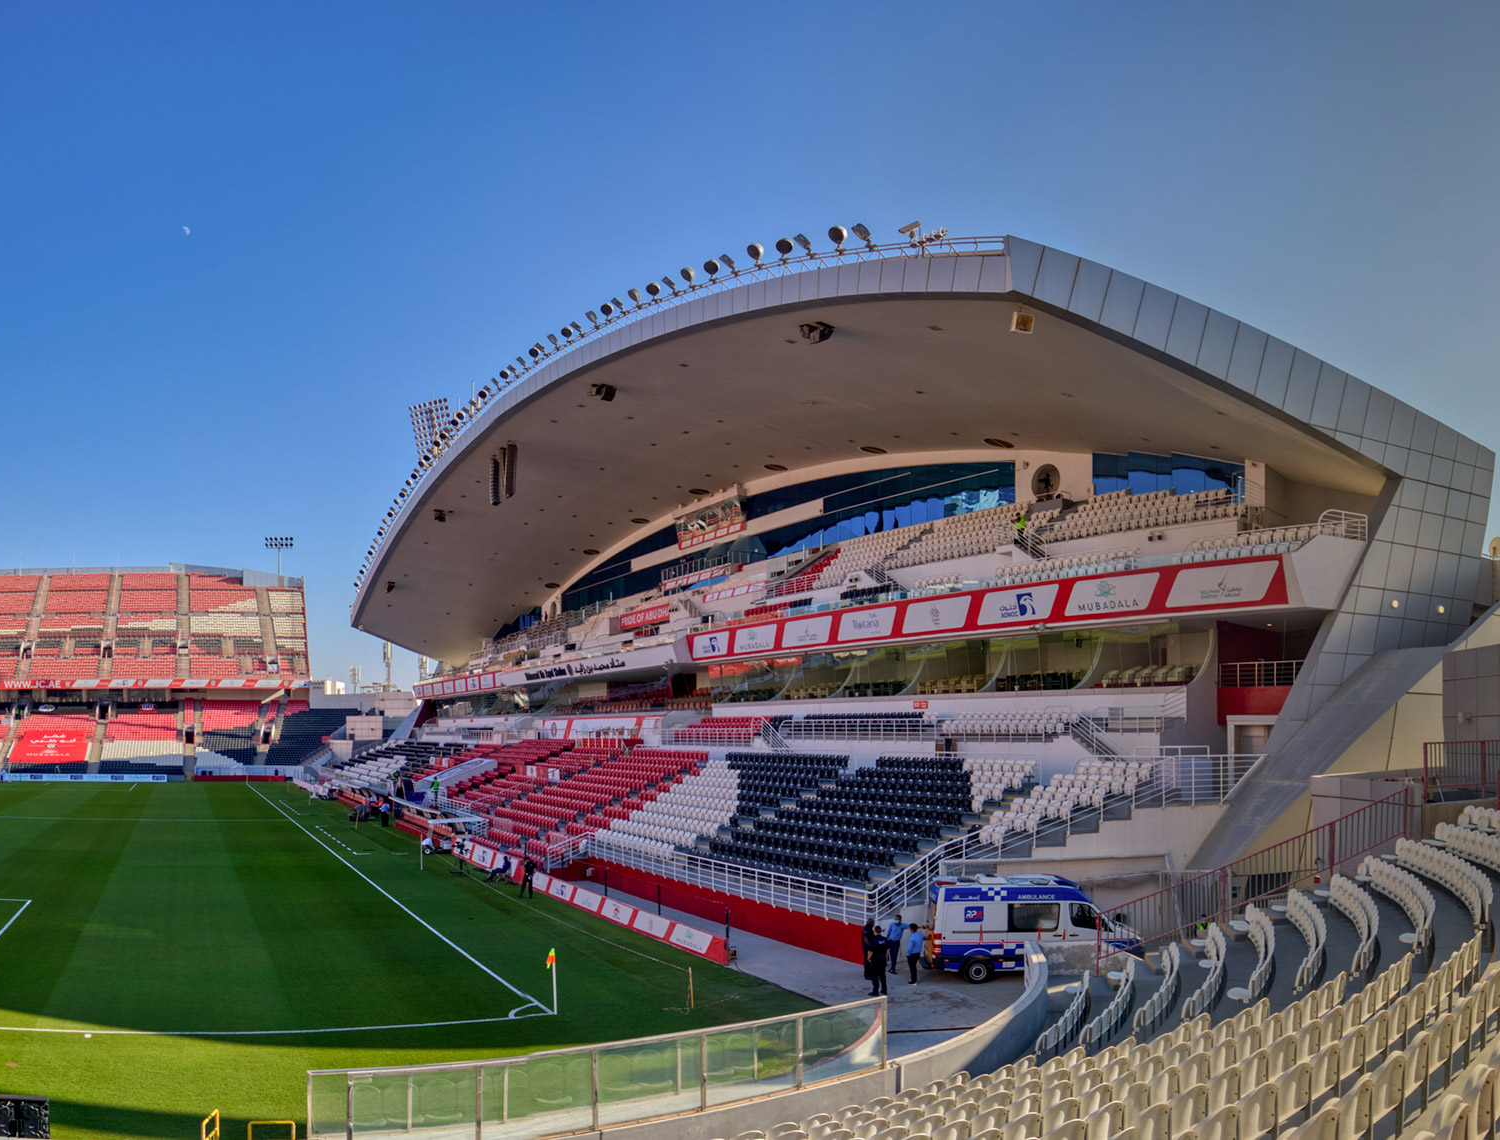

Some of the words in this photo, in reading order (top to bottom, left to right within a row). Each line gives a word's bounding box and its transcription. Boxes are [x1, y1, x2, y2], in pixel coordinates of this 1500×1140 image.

[1078, 598, 1139, 612] MUBADALA
[621, 614, 636, 626] PRIDE
[636, 612, 645, 622] OF
[645, 608, 657, 620] ABU
[852, 619, 880, 631] Rotana
[739, 641, 770, 650] MUBADALA
[3, 680, 62, 689] WWW.JC.AE
